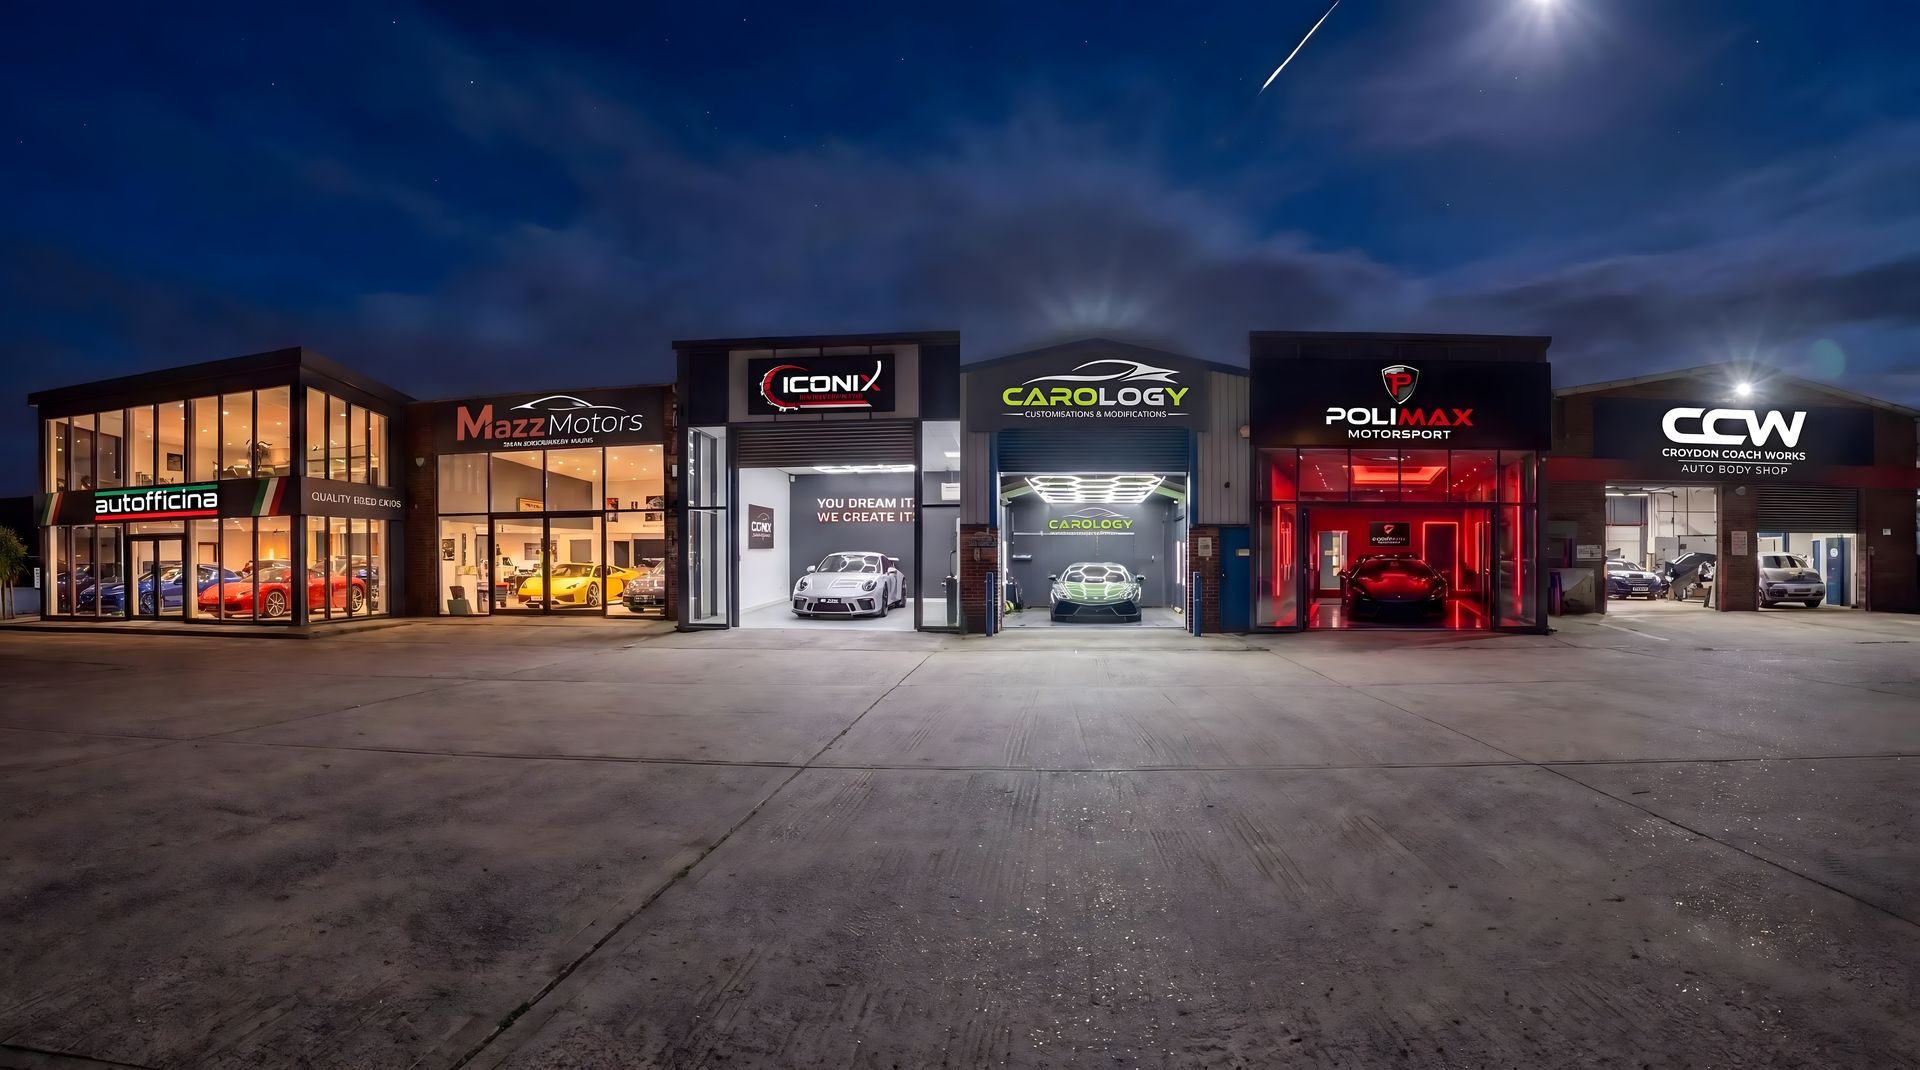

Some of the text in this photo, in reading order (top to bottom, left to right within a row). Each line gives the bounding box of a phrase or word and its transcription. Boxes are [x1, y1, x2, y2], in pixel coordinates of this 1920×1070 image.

[783, 361, 881, 393] ICONIX
[1002, 387, 1189, 406] CAROLOGY
[1025, 410, 1167, 418] CUSTOMISATIONS & MODIFICATIONS
[1325, 407, 1474, 426] POLIMAX
[456, 404, 643, 441] Mazz Motors
[1662, 407, 1807, 448] CCW
[1348, 429, 1452, 440] MOTORSPORT
[1662, 448, 1806, 461] CROYDON COACH WORKS
[1681, 464, 1788, 475] AUTO BODY SHOP
[95, 488, 218, 514] autofficina
[311, 491, 351, 504] QUALITY
[817, 498, 844, 509] YOU
[848, 498, 897, 509] DREAM
[817, 512, 839, 522] WE
[843, 512, 895, 522] CREATE
[1048, 519, 1134, 529] CAROLOGY
